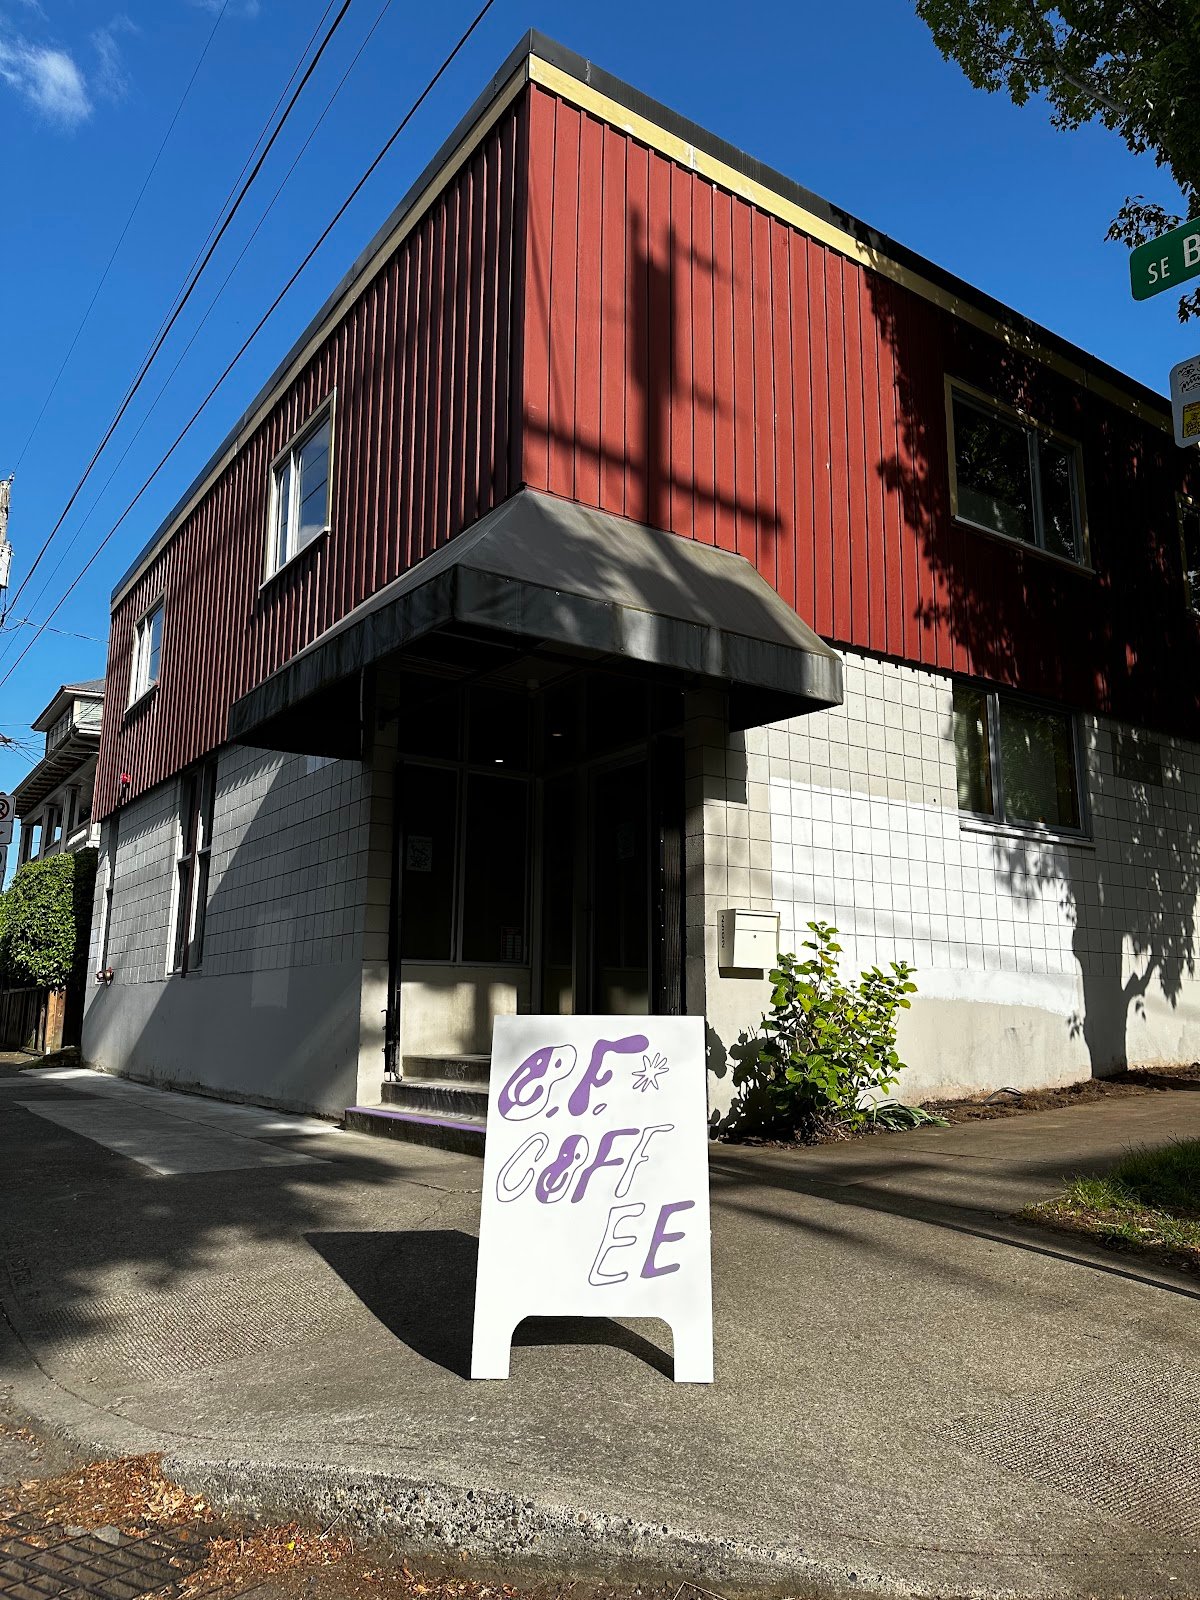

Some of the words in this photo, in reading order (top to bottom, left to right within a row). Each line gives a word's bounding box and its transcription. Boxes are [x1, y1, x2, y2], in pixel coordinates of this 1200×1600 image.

[1147, 256, 1170, 284] SE
[496, 1123, 675, 1204] COFF
[588, 1200, 696, 1286] EE
